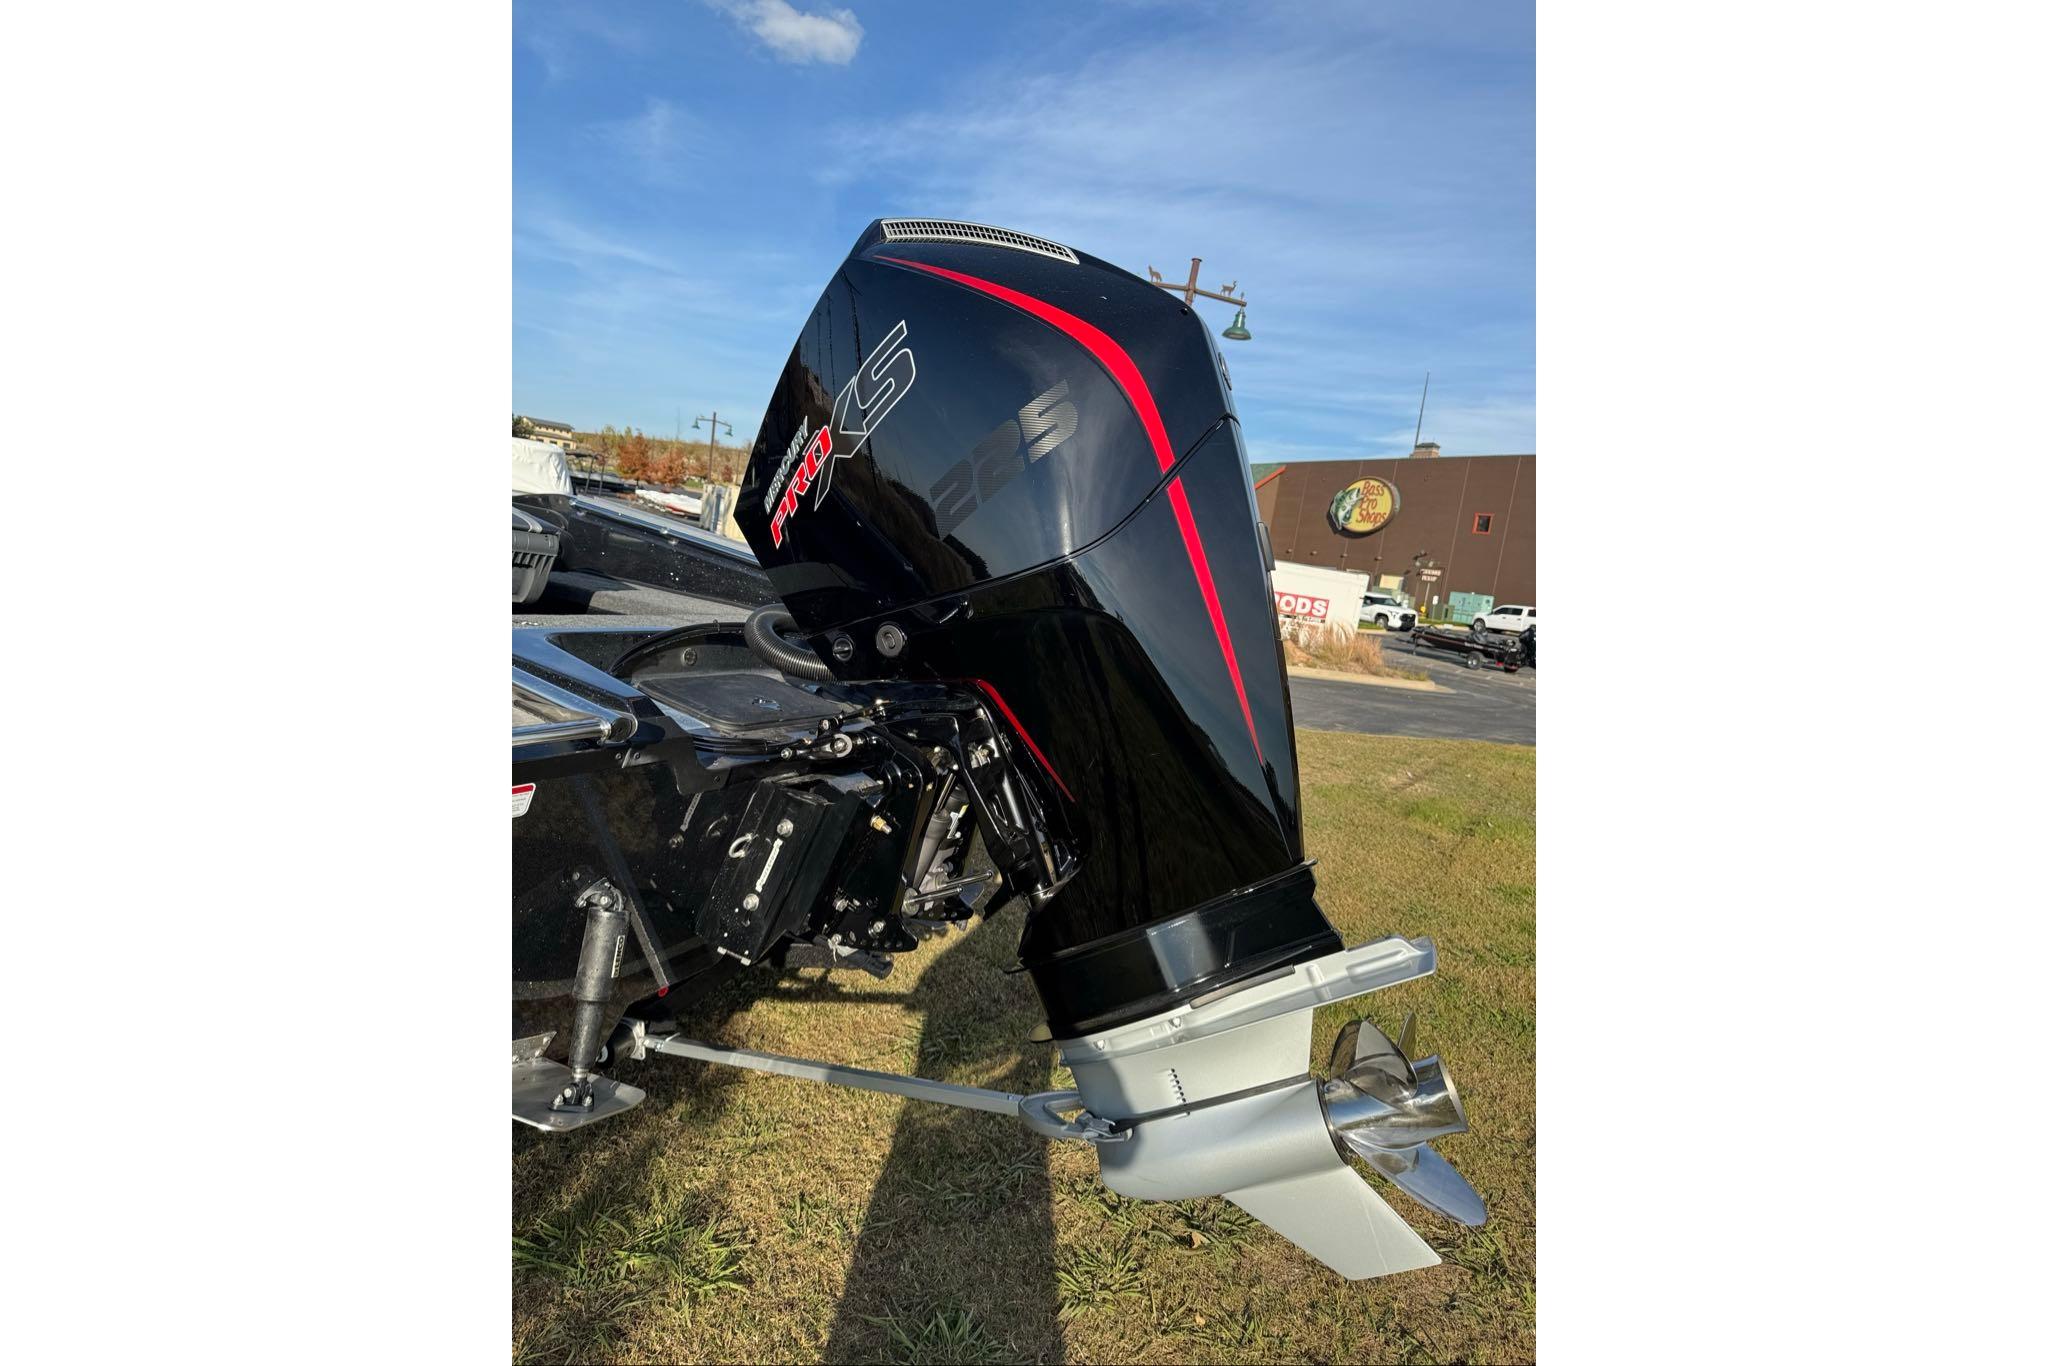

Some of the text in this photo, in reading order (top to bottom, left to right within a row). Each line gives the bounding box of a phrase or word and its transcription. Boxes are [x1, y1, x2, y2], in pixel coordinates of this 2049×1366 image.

[771, 320, 916, 549] PRO XS
[763, 415, 808, 515] MERCURY
[929, 379, 1078, 541] 225
[1361, 481, 1385, 497] Bass
[1359, 494, 1378, 510] Pro
[1356, 509, 1387, 527] Shops
[1274, 594, 1328, 617] ODS
